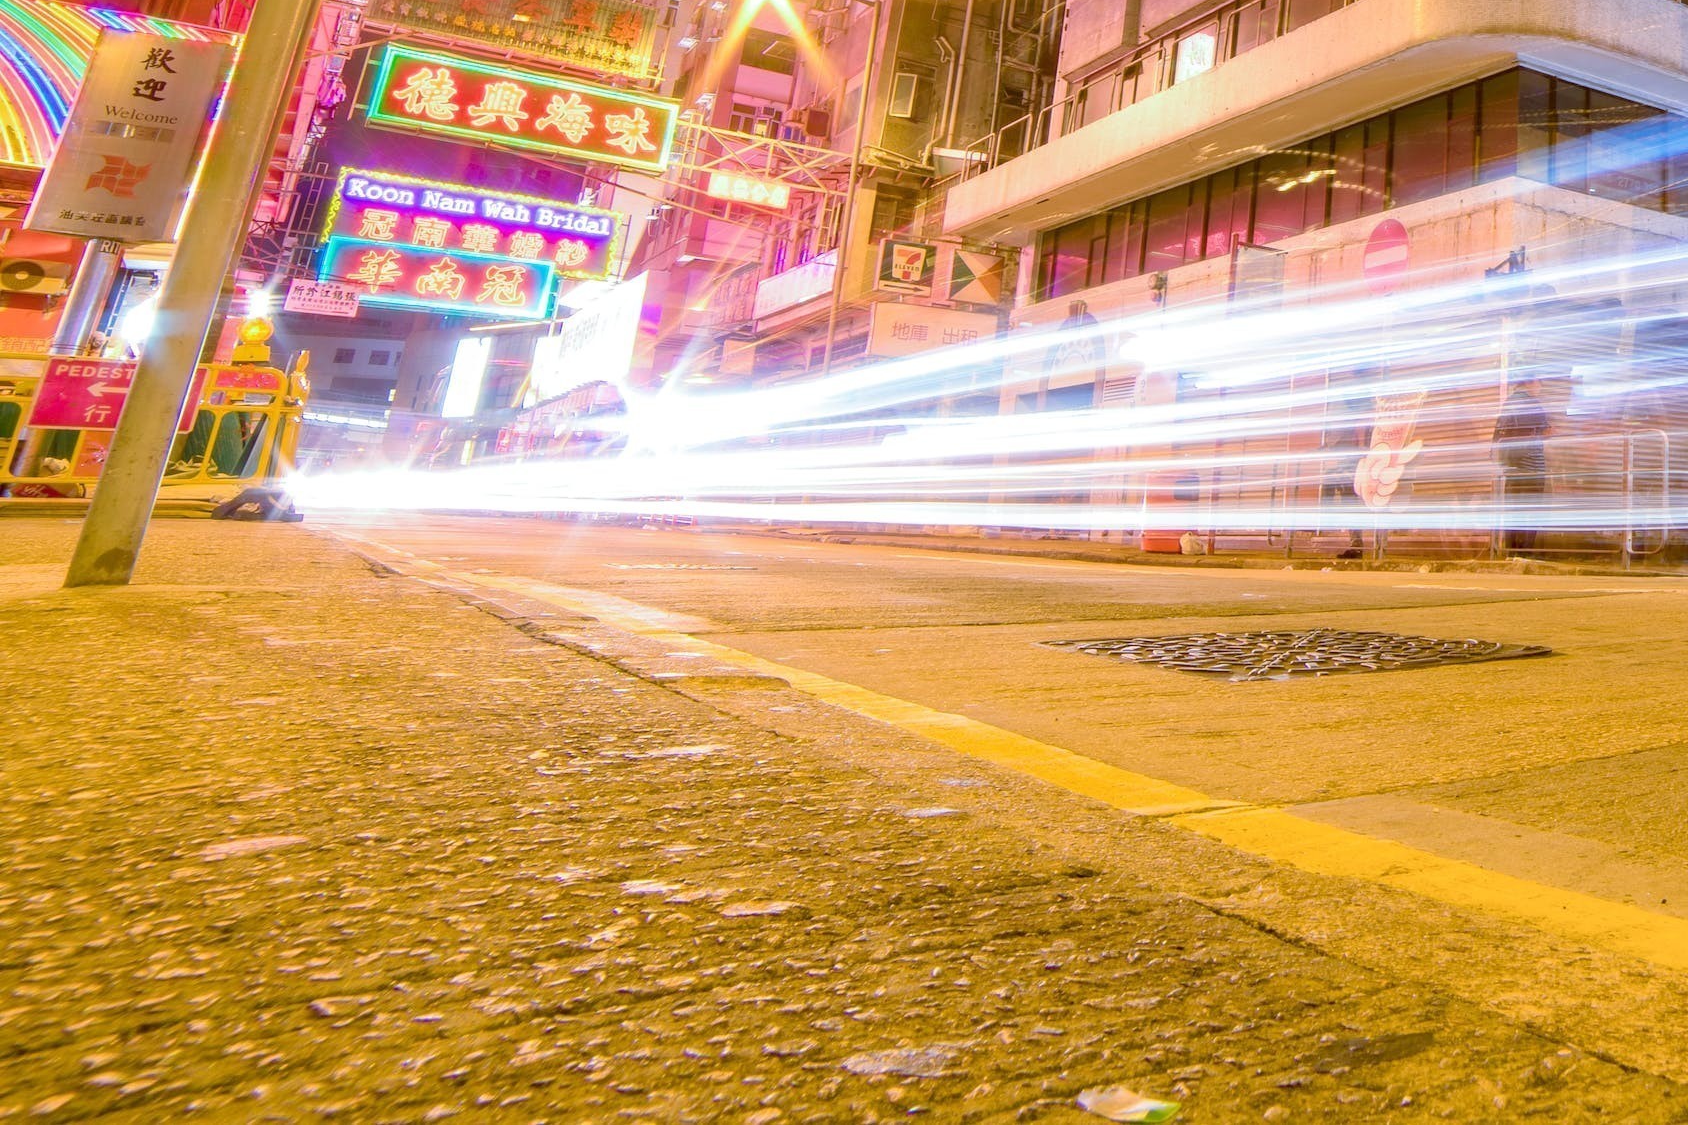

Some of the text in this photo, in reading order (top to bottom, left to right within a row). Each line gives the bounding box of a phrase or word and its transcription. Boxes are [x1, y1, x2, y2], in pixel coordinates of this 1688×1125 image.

[132, 47, 177, 102] 歡迎
[105, 105, 178, 125] Welcome
[393, 67, 657, 154] 德興海味
[347, 177, 611, 236] Koon Nam Wah Bridal
[896, 249, 922, 265] 7
[891, 322, 978, 346] 地庫 出租
